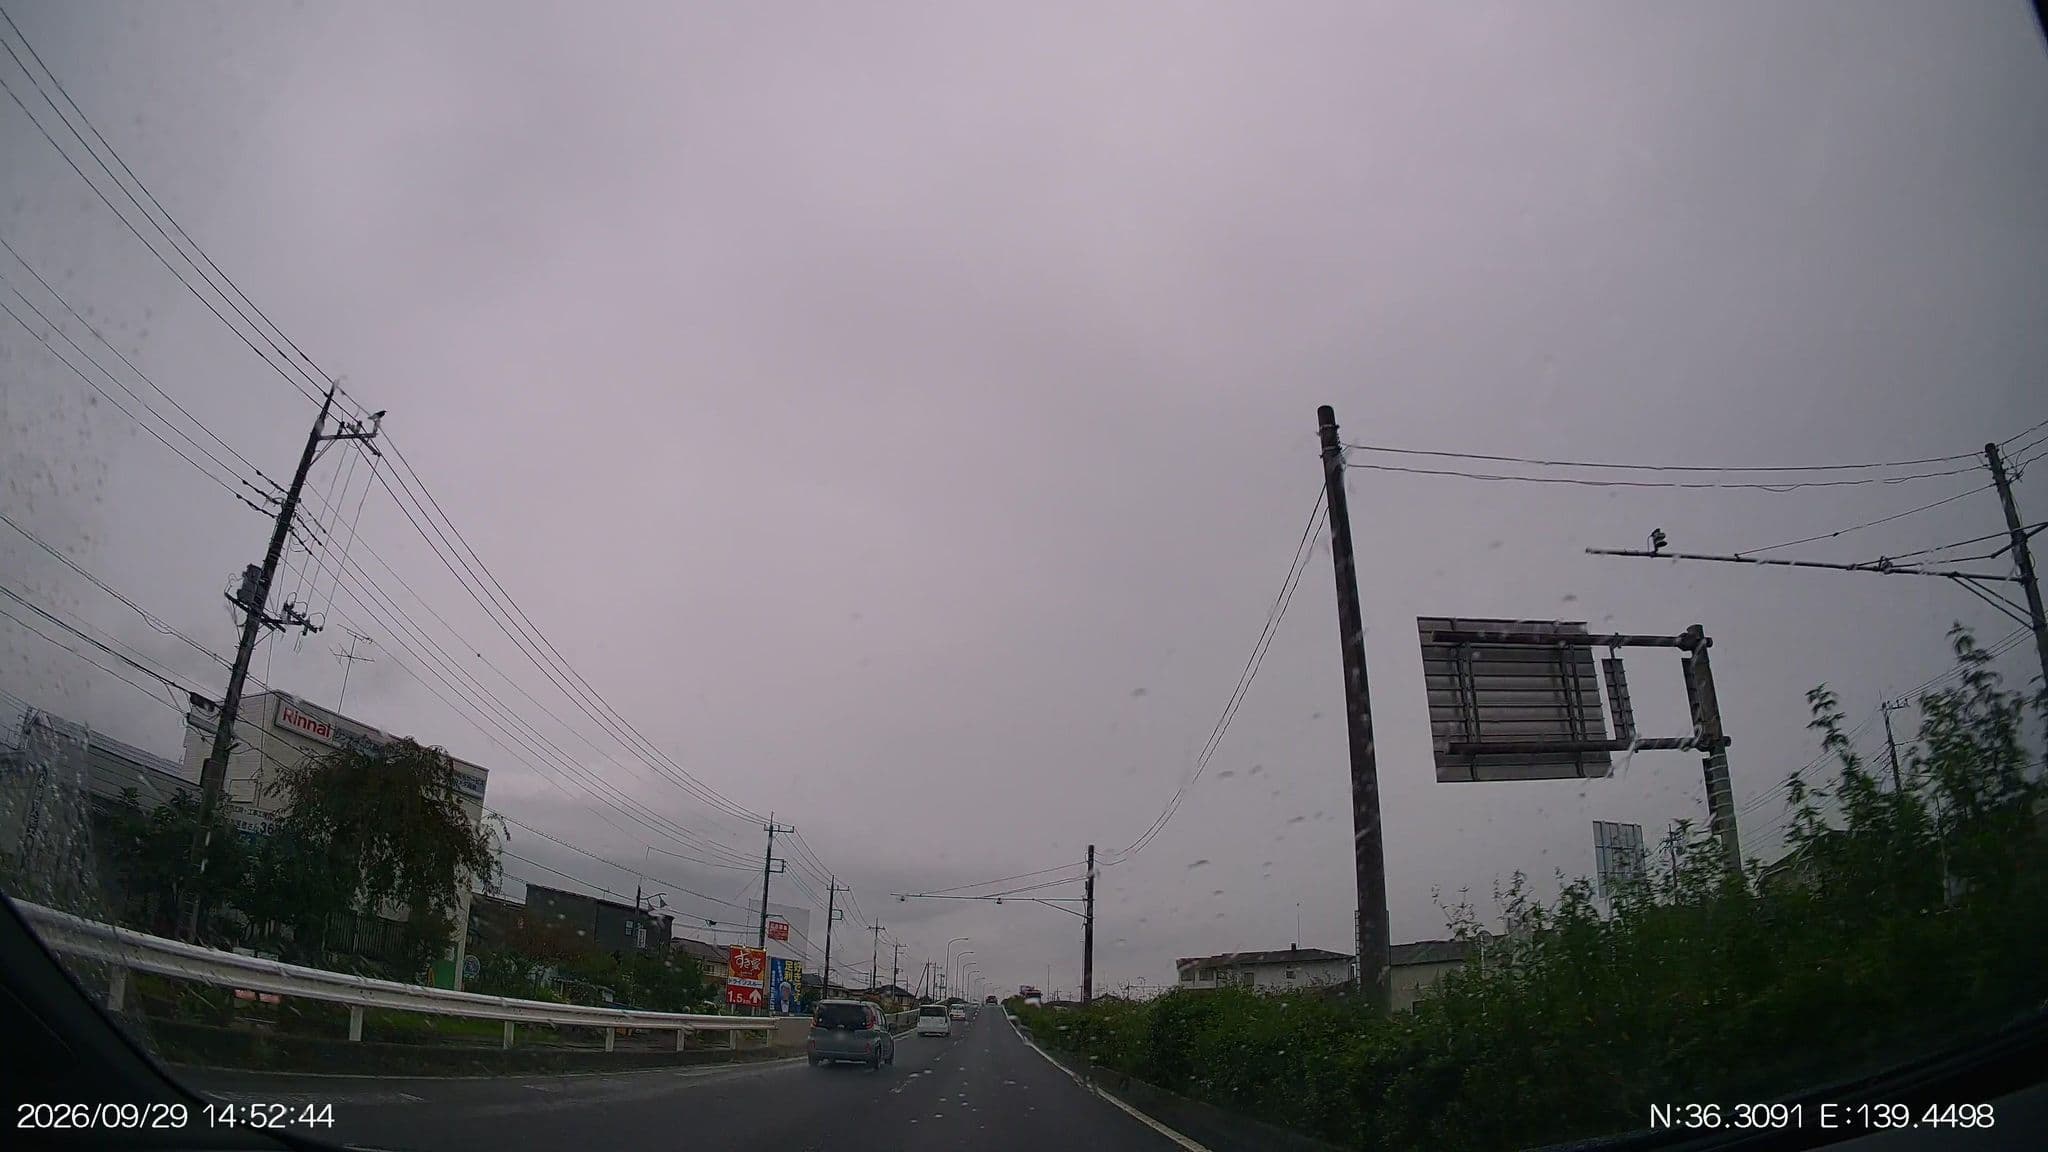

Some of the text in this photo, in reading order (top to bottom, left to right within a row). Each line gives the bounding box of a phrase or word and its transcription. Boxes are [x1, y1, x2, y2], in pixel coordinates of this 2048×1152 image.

[282, 707, 332, 738] Rinnai
[734, 950, 761, 971] すき家
